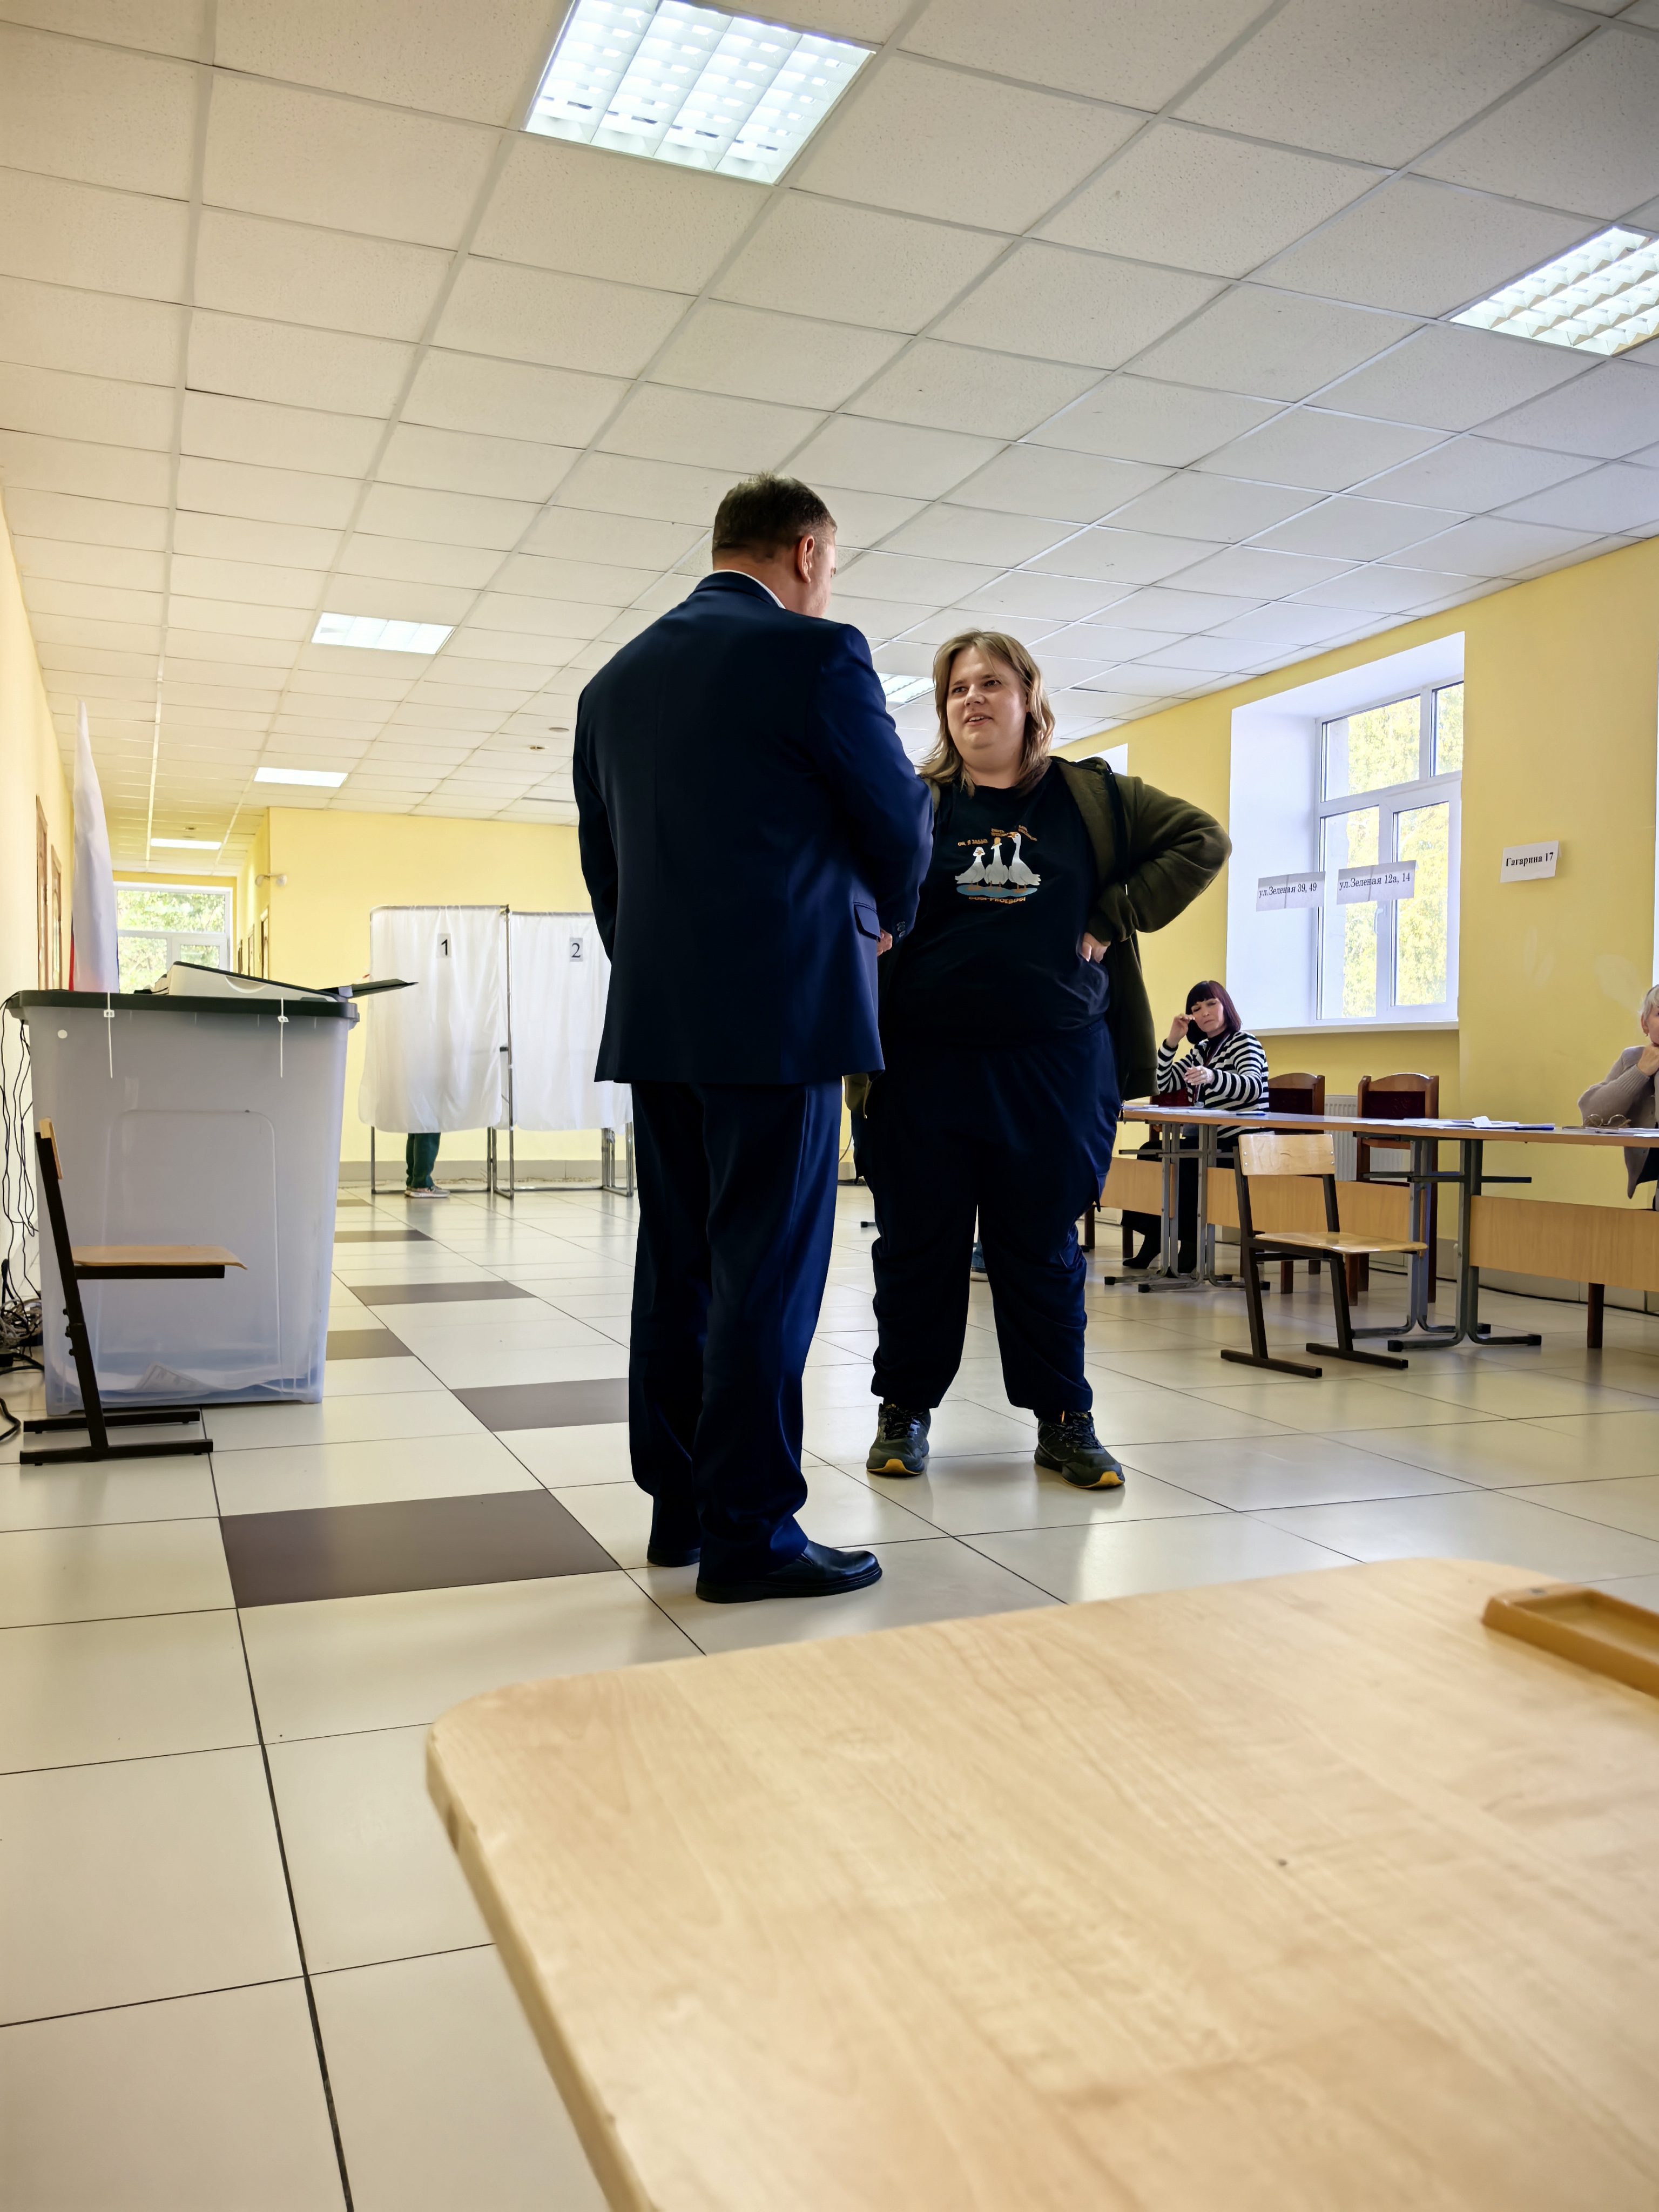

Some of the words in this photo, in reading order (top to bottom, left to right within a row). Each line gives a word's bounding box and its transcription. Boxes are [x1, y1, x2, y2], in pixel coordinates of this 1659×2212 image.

[1506, 856, 1542, 867] Гагарина
[1546, 852, 1554, 862] 17
[1402, 872, 1410, 882] 14
[1297, 883, 1307, 893] 39,
[1309, 882, 1317, 892] 49
[441, 939, 448, 956] 1
[571, 942, 581, 958] 2
